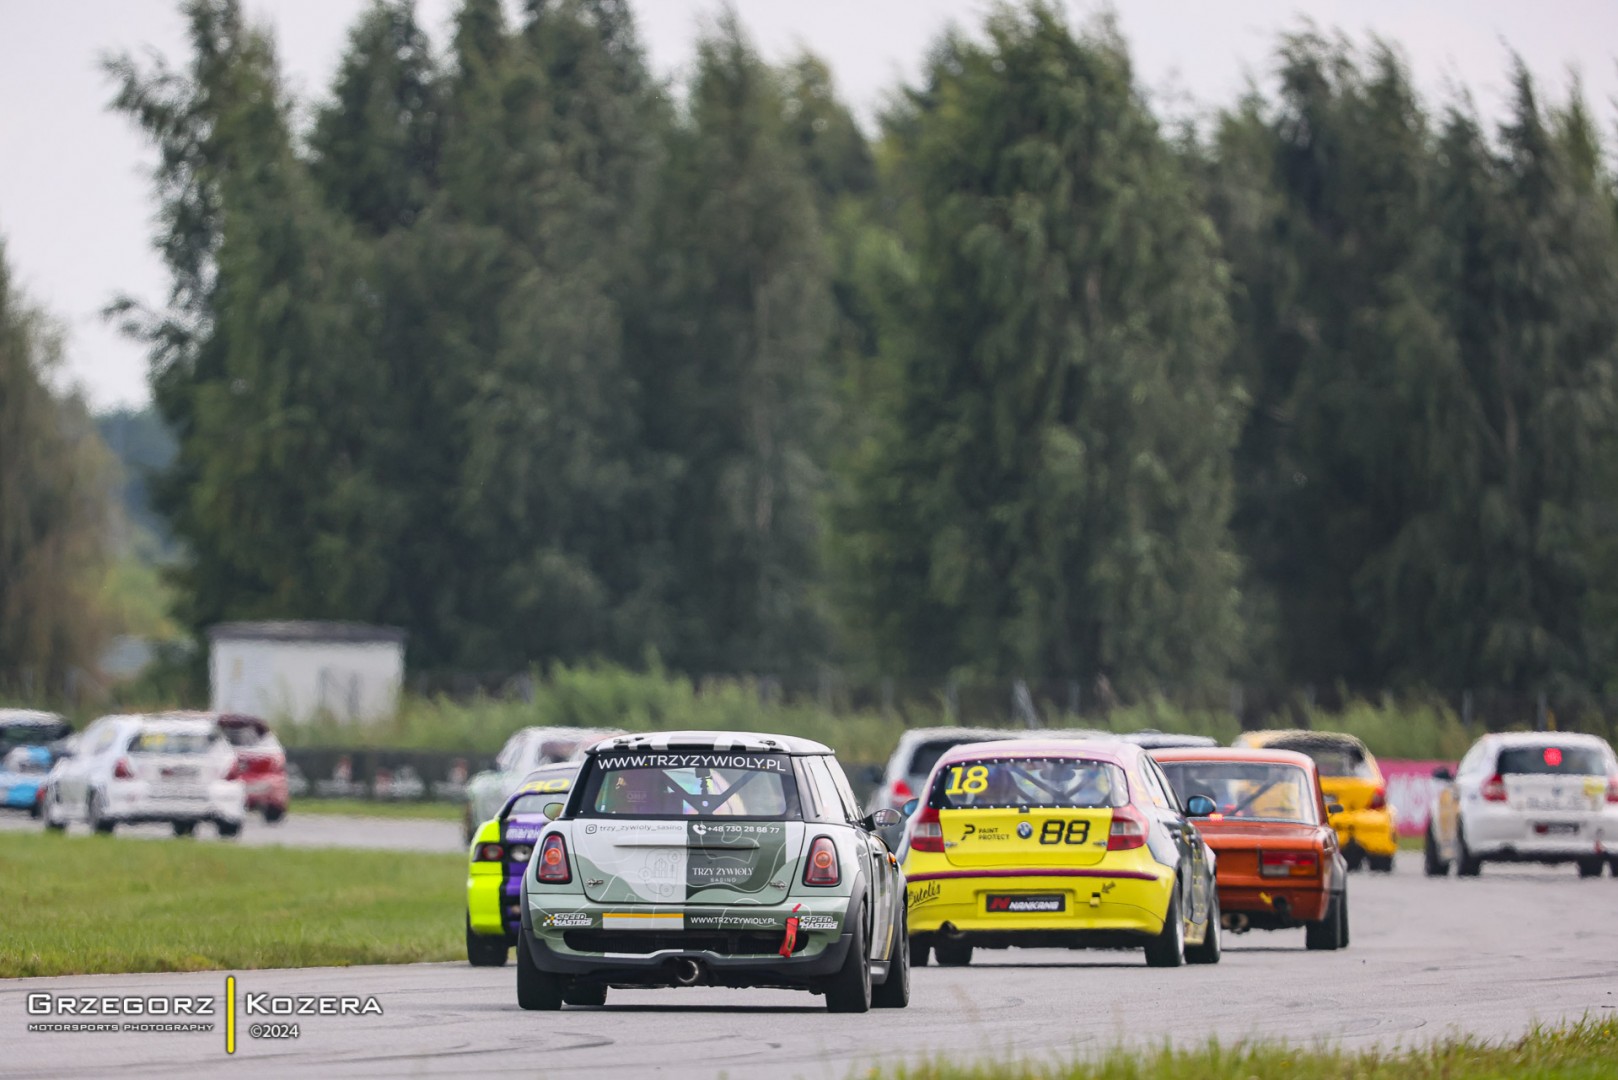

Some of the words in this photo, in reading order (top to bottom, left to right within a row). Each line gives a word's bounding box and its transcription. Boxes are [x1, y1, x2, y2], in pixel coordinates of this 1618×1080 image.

[597, 755, 786, 771] WWW.TRZYZYWIOLY.PL
[945, 766, 989, 795] 18
[756, 826, 768, 834] 88
[1039, 819, 1091, 845] 88
[692, 867, 714, 876] TRZY
[1009, 901, 1060, 910] NANKANG
[690, 916, 777, 925] WWW.TRZYZYWIOLY.PL
[803, 915, 833, 923] SPEED
